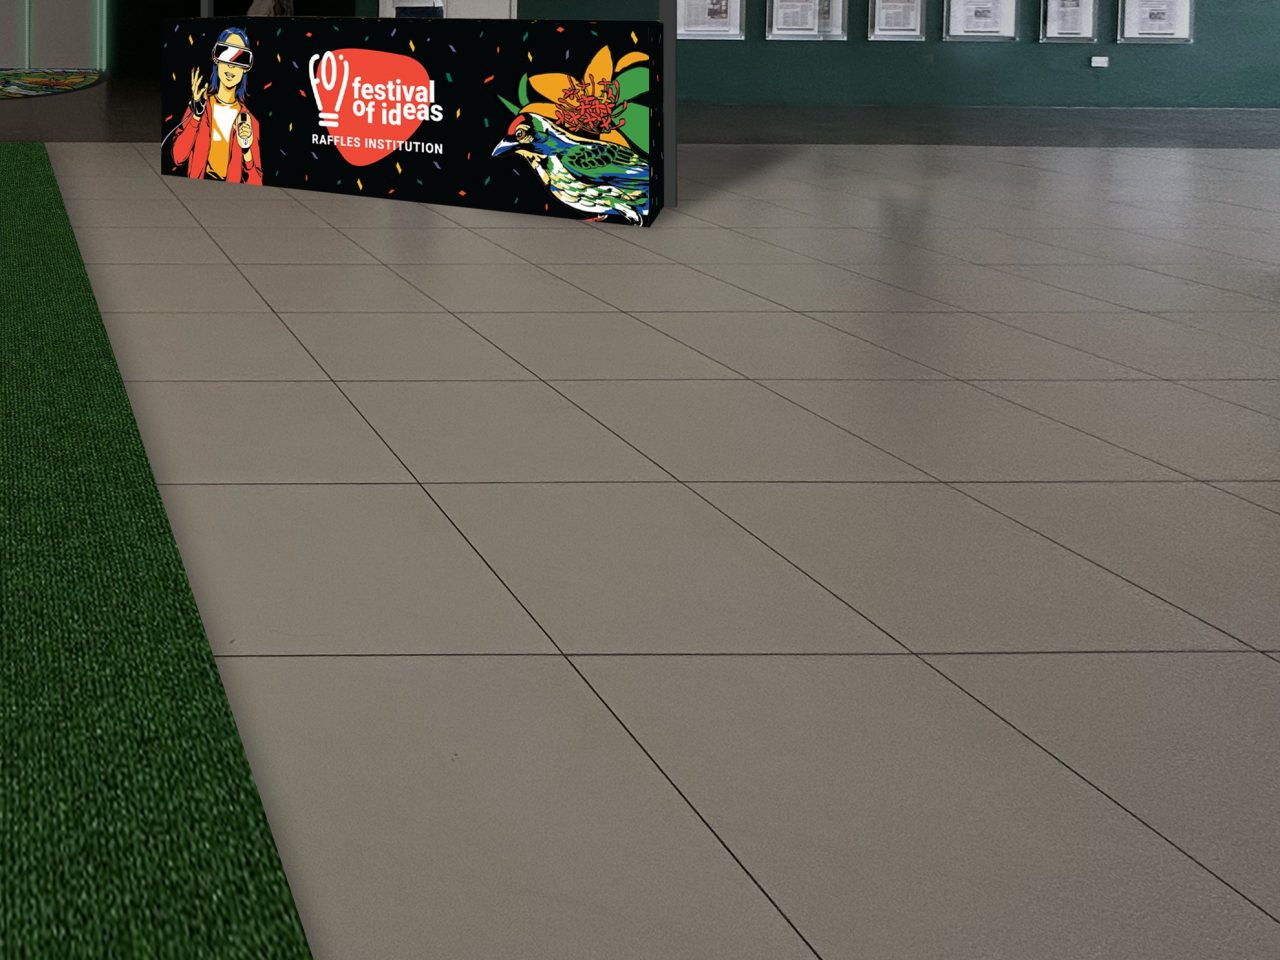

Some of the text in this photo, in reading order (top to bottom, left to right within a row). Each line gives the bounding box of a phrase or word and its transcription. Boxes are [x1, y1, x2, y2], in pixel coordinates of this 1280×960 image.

[352, 76, 435, 103] festival
[352, 100, 444, 126] of ideas
[312, 134, 444, 154] RAFFLES INSTITUTION
